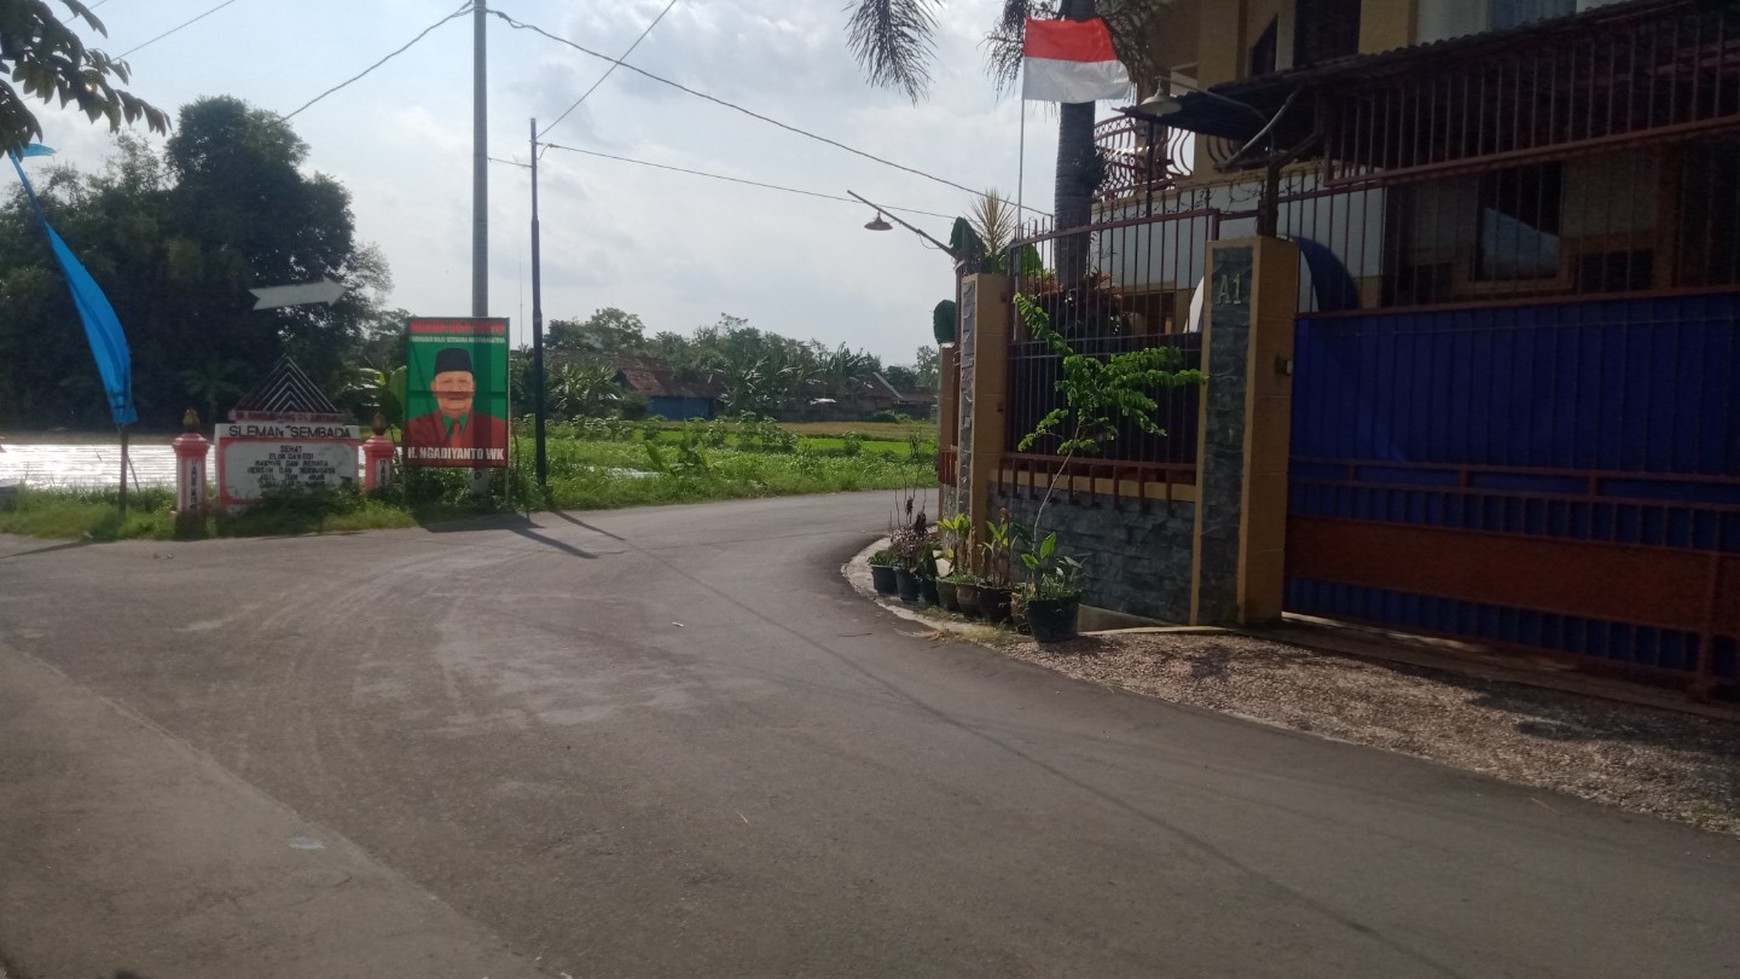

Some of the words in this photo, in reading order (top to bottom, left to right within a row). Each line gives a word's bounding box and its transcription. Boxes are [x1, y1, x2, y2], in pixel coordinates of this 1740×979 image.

[228, 425, 284, 437] SLEMAN
[280, 445, 302, 453] SEHAT
[408, 447, 417, 459] H.
[420, 447, 484, 460] NGADIYANTO
[486, 448, 504, 460] WK
